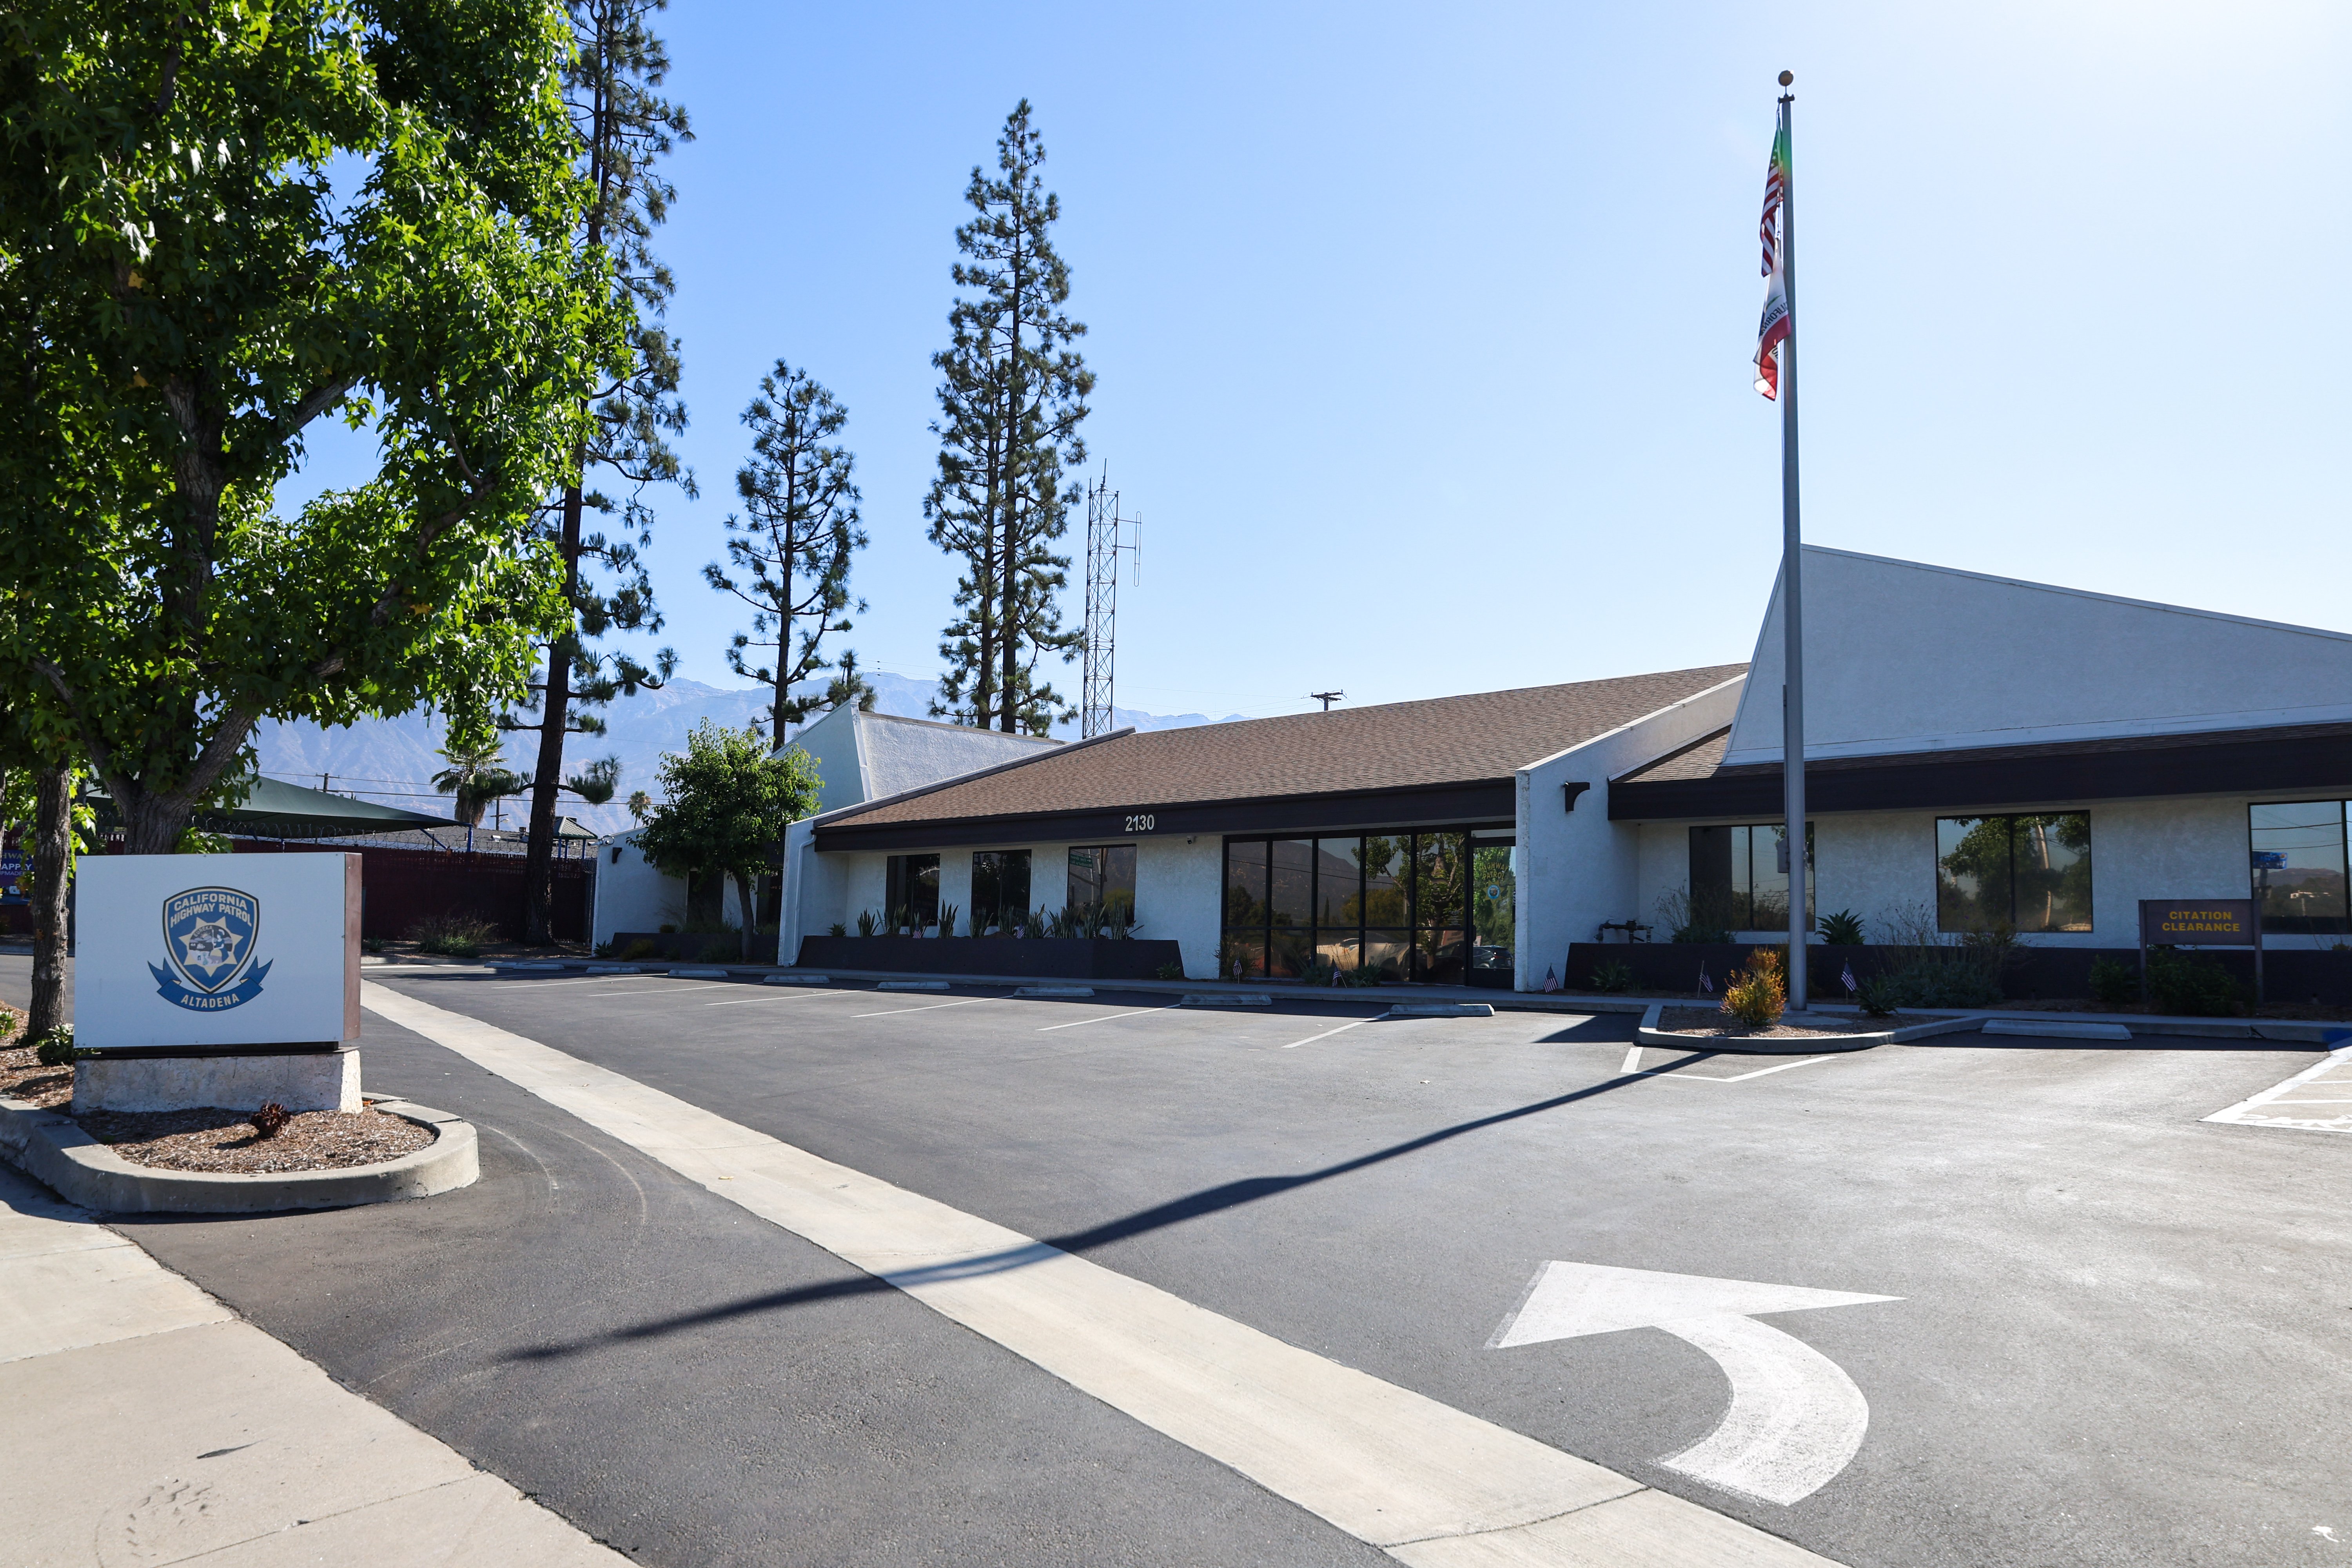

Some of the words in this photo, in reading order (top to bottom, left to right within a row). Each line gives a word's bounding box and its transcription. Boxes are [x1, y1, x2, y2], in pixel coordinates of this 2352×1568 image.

[1125, 814, 1155, 831] 2130
[1482, 862, 1509, 872] HIGHWAY
[1483, 871, 1504, 880] PATROL
[174, 893, 247, 911] CALIFORNIA
[170, 903, 215, 928] HIGHWAY
[219, 904, 252, 927] PATROL
[2169, 911, 2232, 920] CITATION
[193, 926, 213, 937] EUREKA
[2162, 922, 2240, 932] CLEARANCE
[181, 993, 240, 1008] ALTADENA
